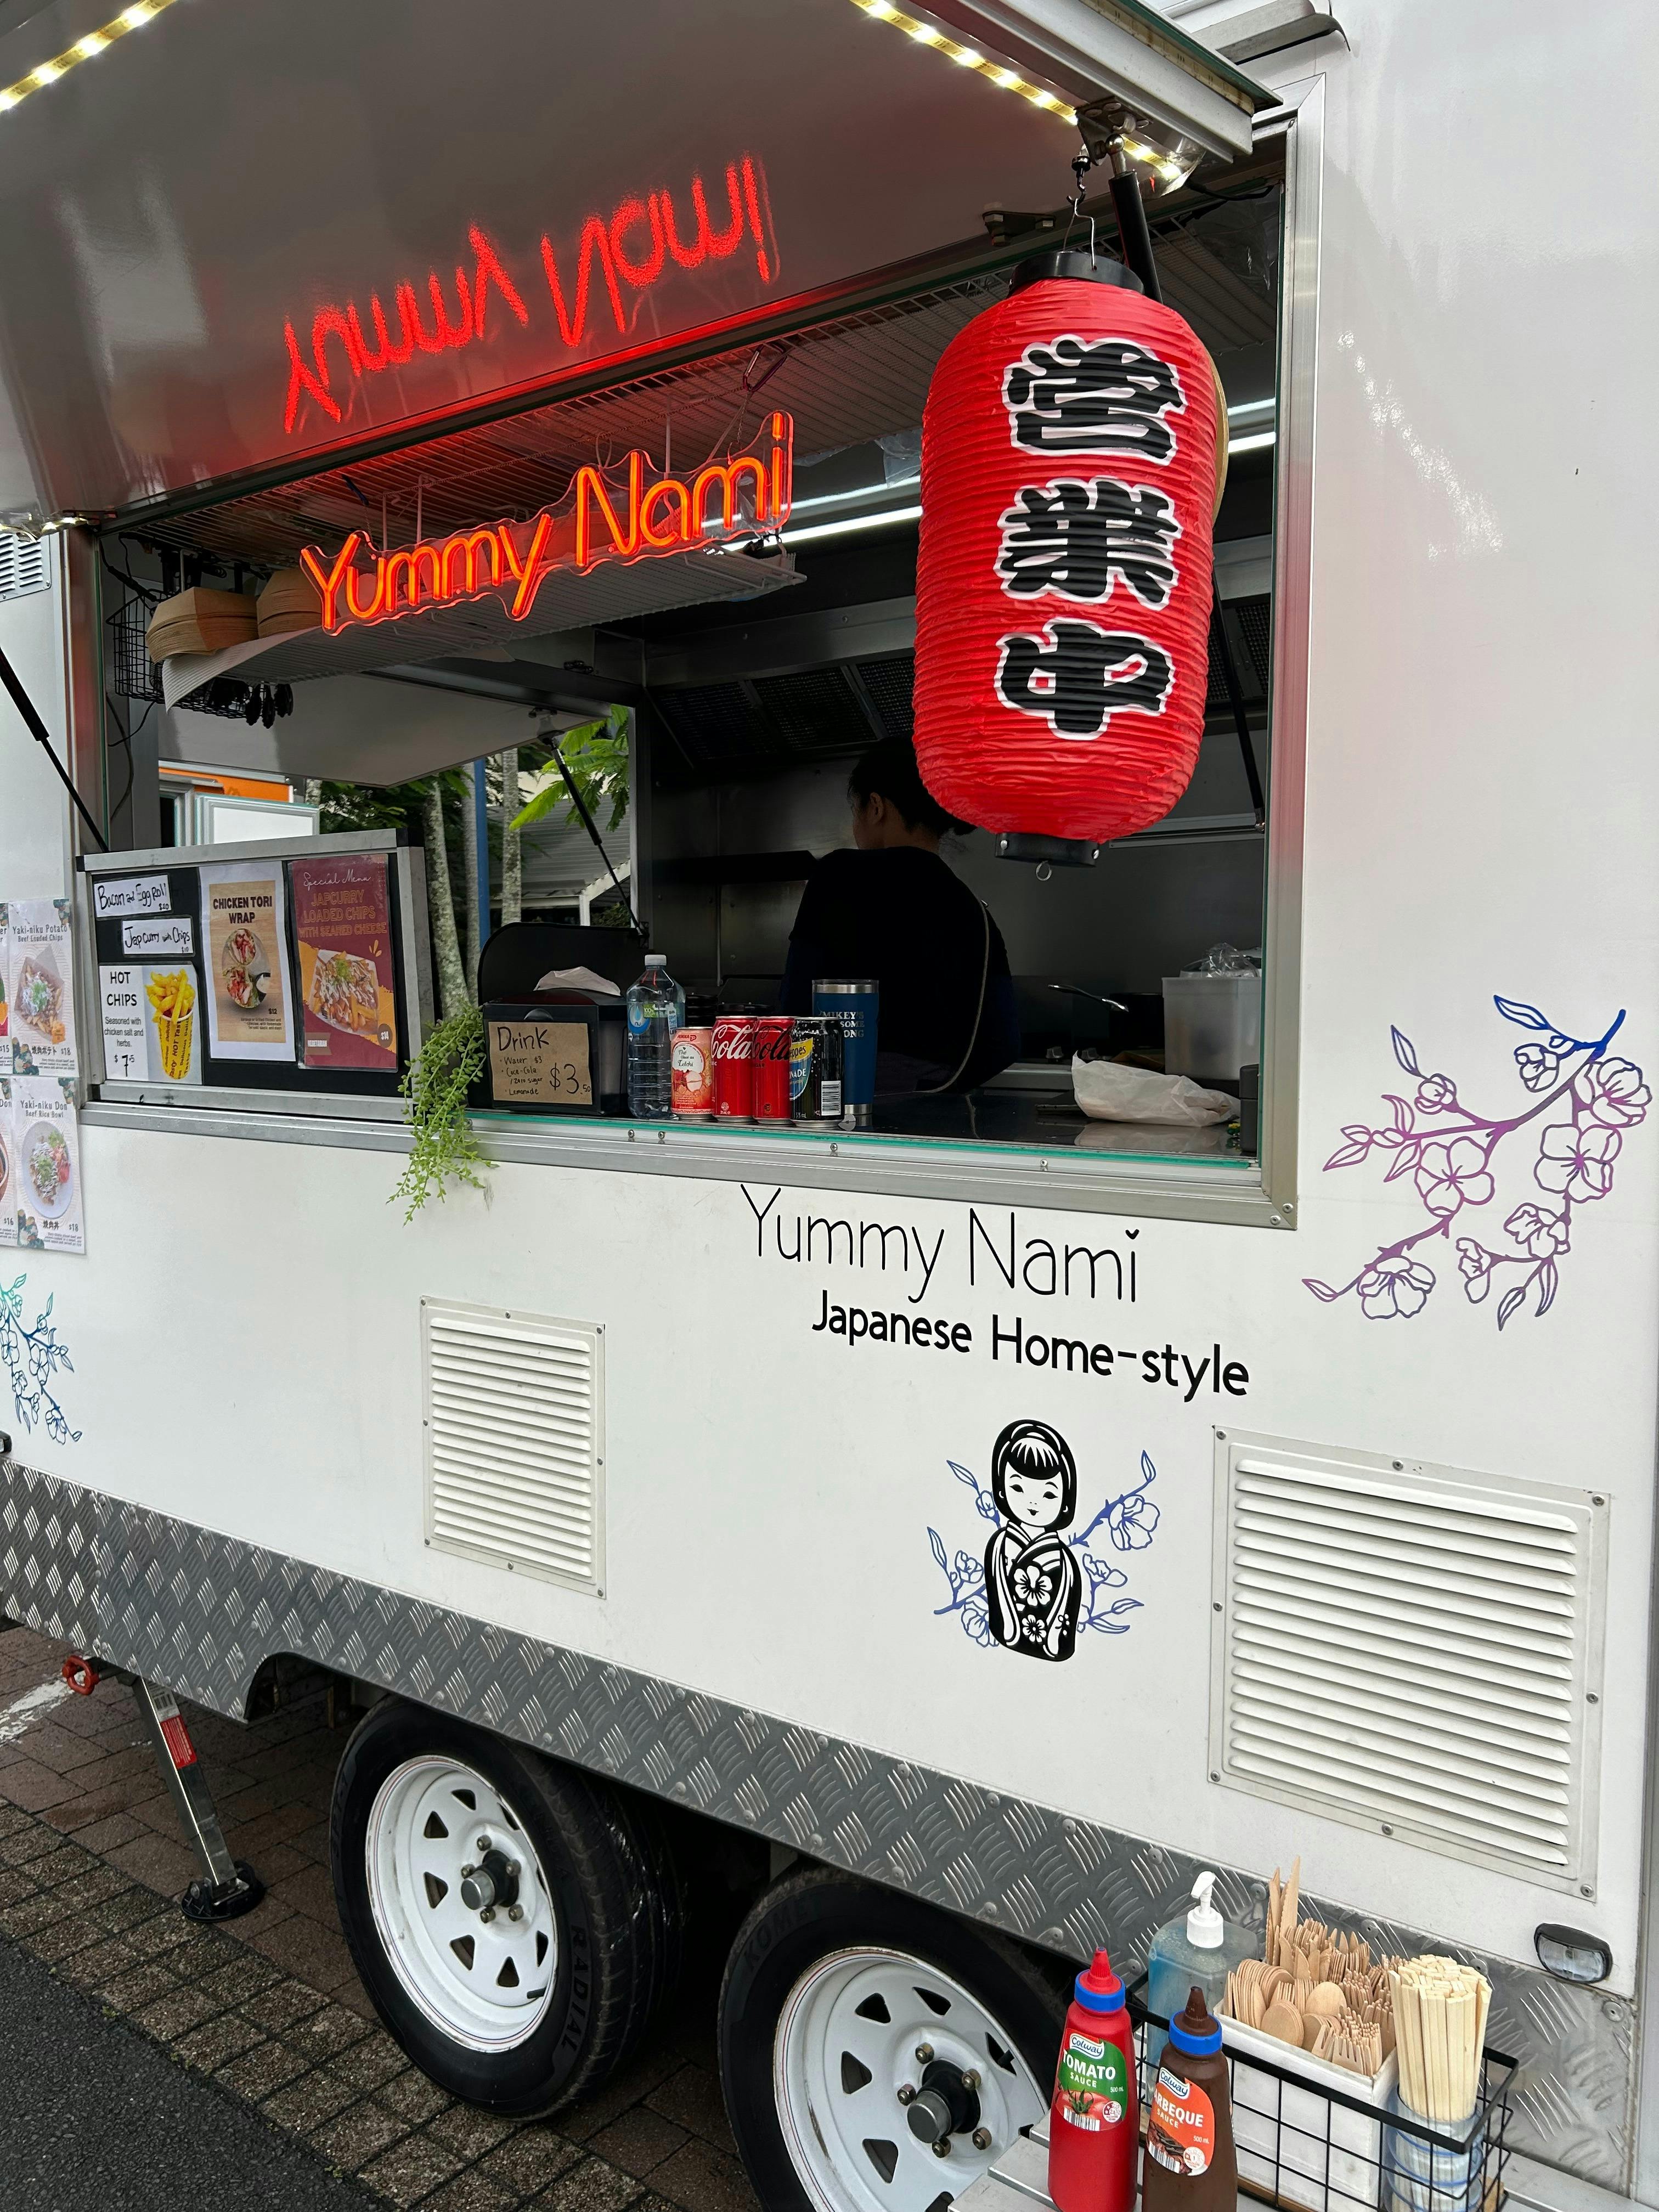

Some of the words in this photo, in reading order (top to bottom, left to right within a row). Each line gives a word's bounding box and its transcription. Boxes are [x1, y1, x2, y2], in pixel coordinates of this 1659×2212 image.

[301, 514, 553, 630] Yummy
[575, 411, 784, 567] Nami
[303, 872, 341, 891] Special
[342, 868, 371, 883] Menu
[98, 885, 125, 910] Bacon
[213, 897, 249, 909] CHICKEN
[250, 896, 272, 907] TORI
[311, 889, 365, 906] JAPCURRY
[229, 912, 255, 924] WRAP
[304, 908, 343, 923] LOADED
[346, 905, 376, 921] CHIPS
[13, 924, 43, 935] Yaki-niku
[46, 924, 67, 933] Potato
[172, 927, 190, 944] Chips
[298, 927, 319, 938] WITH
[320, 924, 352, 937] SEARED
[354, 922, 387, 935] CHEESE
[110, 970, 131, 984] HOT
[106, 993, 137, 1007] CHIPS
[105, 1017, 130, 1025] Seasoned
[131, 1017, 142, 1025] with
[134, 1028, 144, 1036] and
[381, 1031, 389, 1040] $14
[497, 1026, 550, 1052] Drink
[61, 1047, 71, 1056] $18
[504, 1057, 527, 1065] Water
[534, 1056, 543, 1064] $3
[509, 1087, 539, 1096] Lemonade
[20, 1100, 53, 1110] Yaki-niku
[55, 1101, 67, 1110] Don
[39, 1110, 50, 1118] Rice
[4, 1217, 14, 1226] $16
[69, 1223, 79, 1232] $18
[741, 1183, 945, 1304] Yummy
[969, 1207, 1140, 1303] Nami
[812, 1289, 973, 1353] Japanese
[992, 1313, 1250, 1403] Home-style
[560, 1925, 592, 2053] RADIAL
[1071, 2036, 1103, 2054] Colway
[1063, 2049, 1116, 2080] TOMATO
[1070, 2072, 1097, 2088] SAUCE
[1160, 2071, 1188, 2095] Colway
[1157, 2108, 1179, 2129] SAUCE
